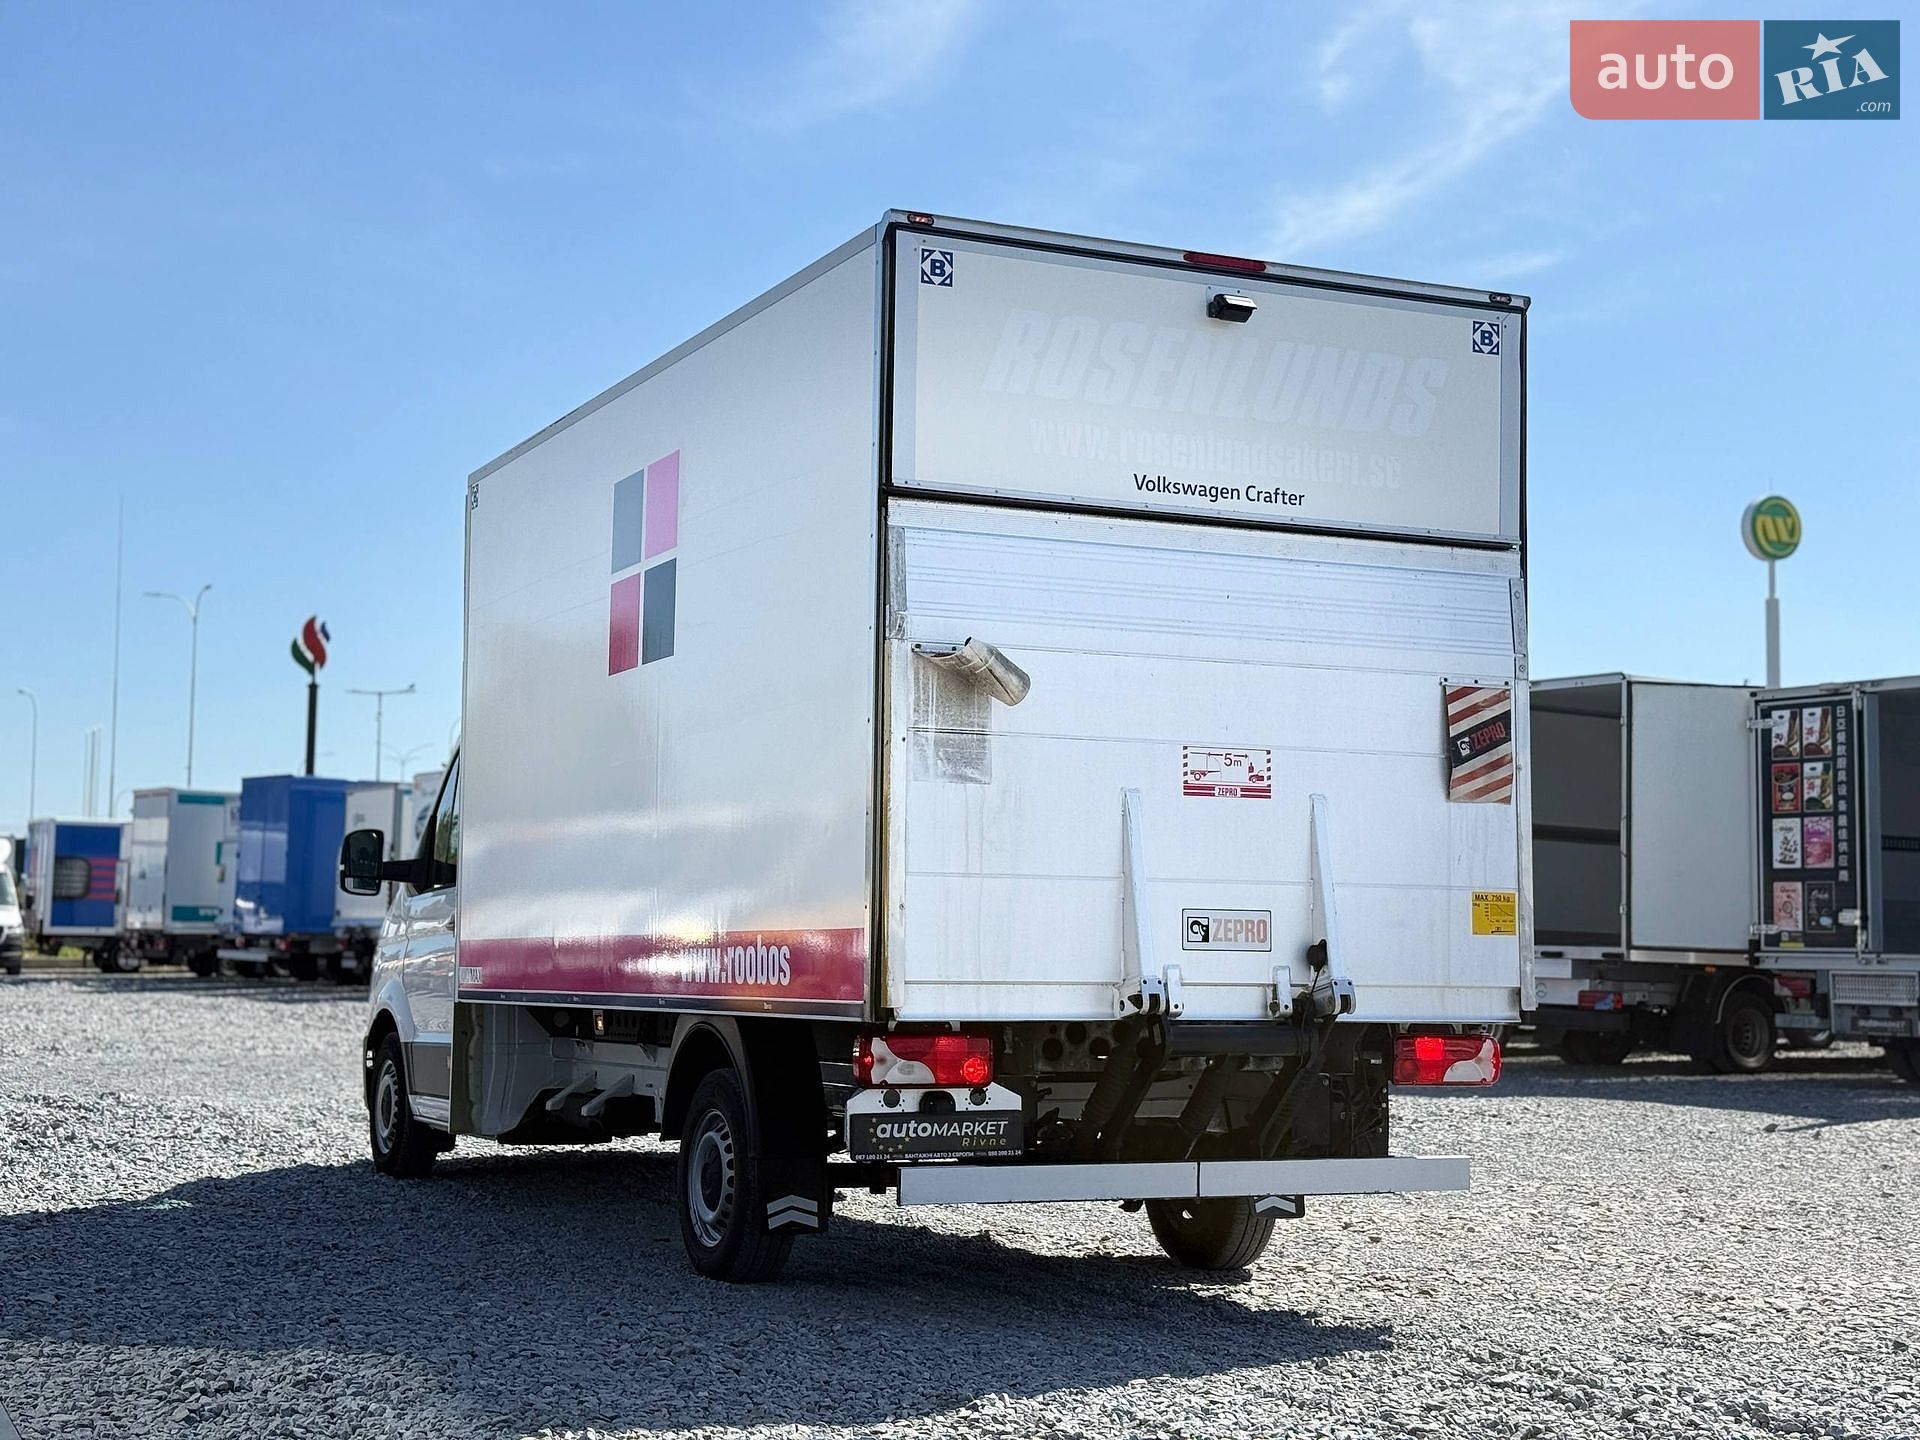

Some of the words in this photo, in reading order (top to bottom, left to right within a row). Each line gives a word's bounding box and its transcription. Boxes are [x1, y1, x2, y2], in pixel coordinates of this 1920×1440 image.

[980, 308, 1450, 438] ROSENLUNDS
[1133, 473, 1241, 503] Volkswagen
[1245, 485, 1305, 506] Crafter
[1470, 721, 1506, 752] ZEPRO
[1216, 786, 1239, 797] ZEPRO
[1212, 917, 1268, 944] ZEPRO
[876, 1119, 1009, 1139] autoMARKET
[961, 1137, 1007, 1147] Rivne
